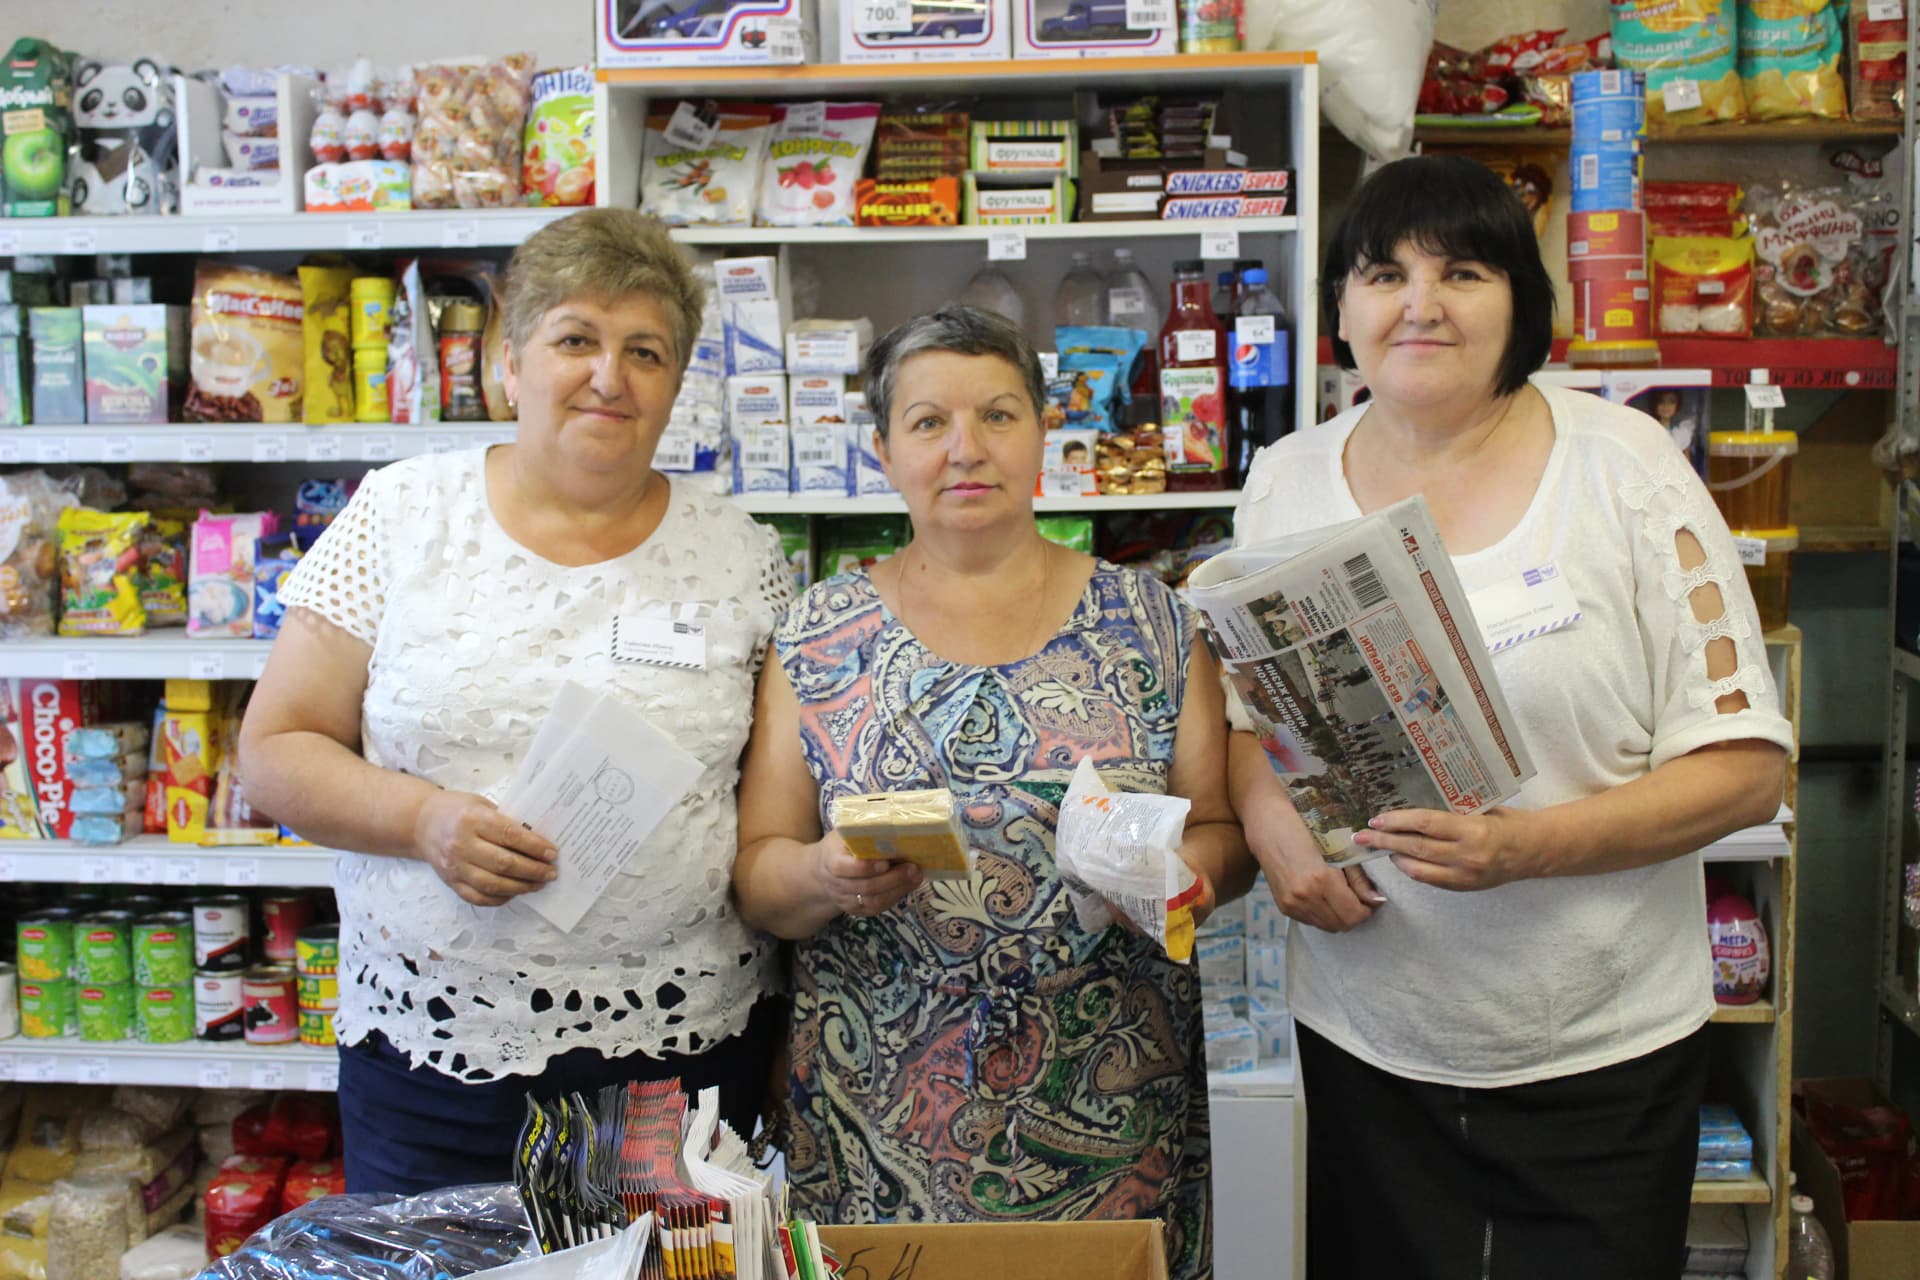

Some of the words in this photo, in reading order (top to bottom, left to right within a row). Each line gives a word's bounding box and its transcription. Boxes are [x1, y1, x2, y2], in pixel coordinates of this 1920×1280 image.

[1169, 173, 1244, 193] SNICKERS
[1248, 172, 1287, 190] SUPER
[860, 203, 931, 217] MELLER
[1166, 199, 1241, 218] SNICKERS
[1243, 197, 1284, 216] SUPER
[1358, 633, 1393, 684] ОЧЕРЕДИ!
[1252, 664, 1277, 696] ЗАКОН
[1262, 661, 1290, 697] ЖИЗНИ
[1385, 682, 1403, 704] БЕЗ
[1269, 693, 1306, 744] ОСНОВНОЙ
[1282, 693, 1309, 729] НАШЕЙ
[1409, 722, 1430, 750] 2020
[1423, 747, 1457, 799] ПОДПИСКА
